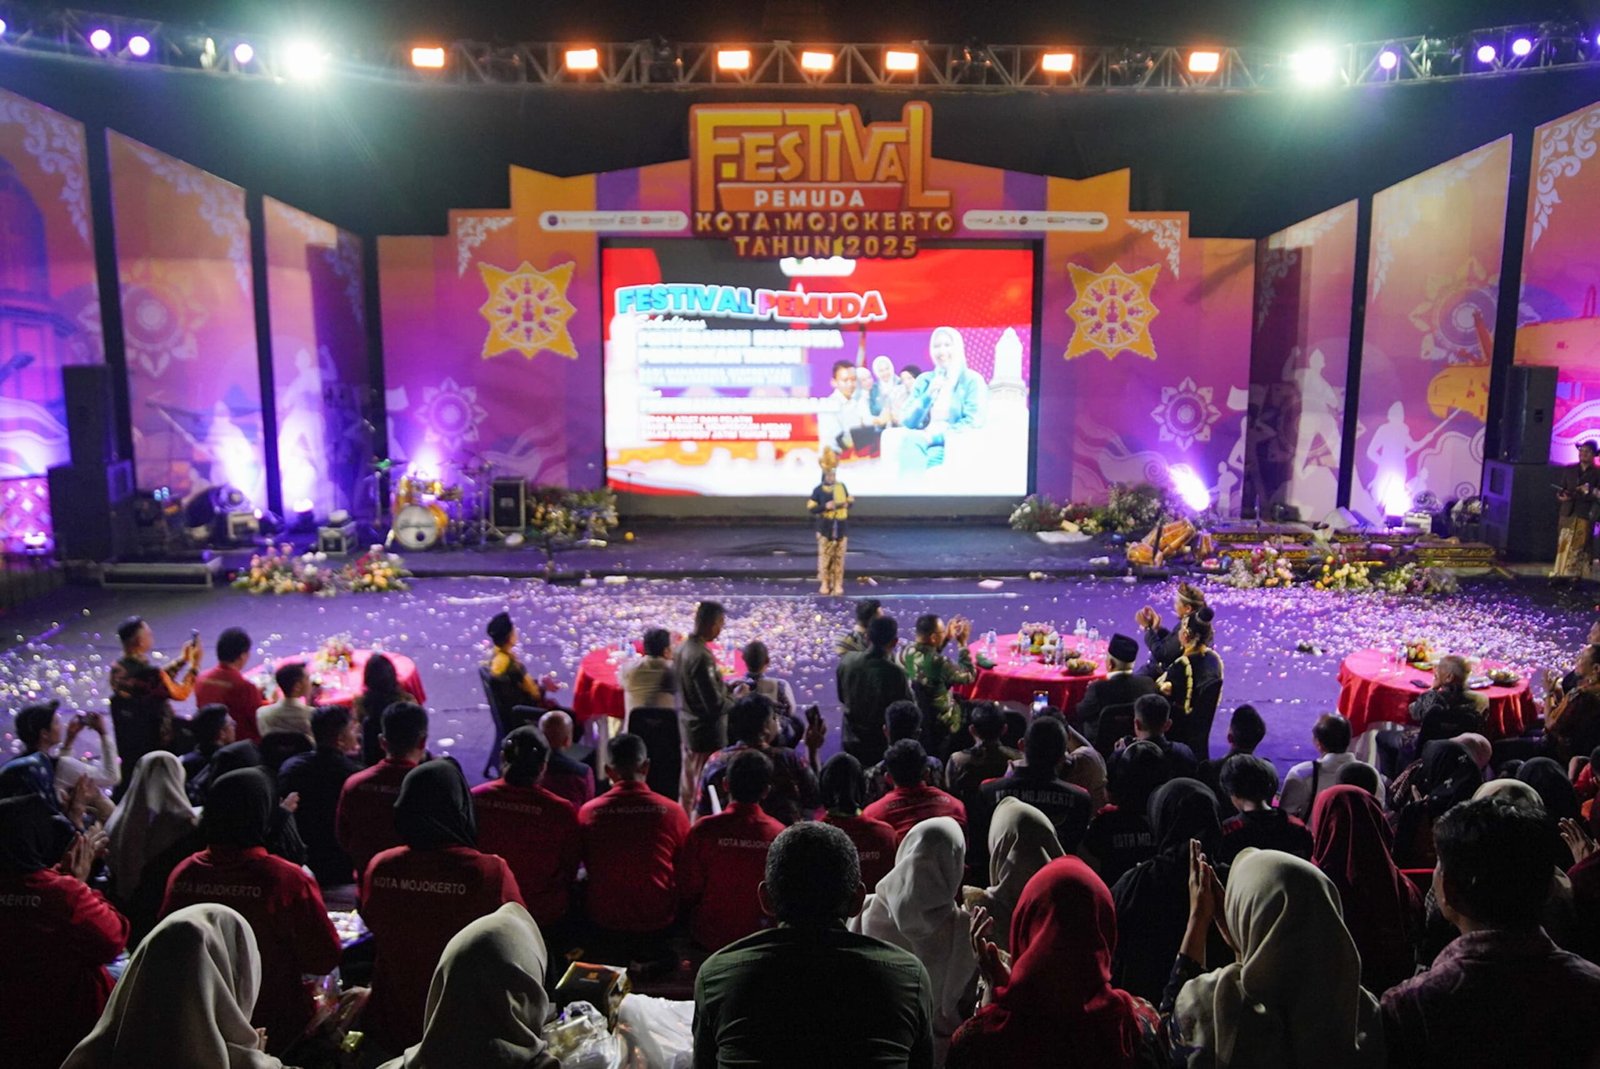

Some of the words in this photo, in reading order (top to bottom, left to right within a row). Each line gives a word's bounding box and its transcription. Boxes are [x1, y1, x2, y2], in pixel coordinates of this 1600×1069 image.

[754, 189, 865, 208] PEMUDA
[697, 212, 770, 232] KOTA
[784, 211, 953, 232] MOJOKERTO
[735, 236, 831, 257] TAHUN
[845, 236, 917, 257] 2025
[617, 285, 756, 316] FESTIVAL
[757, 290, 886, 321] PEMUDA
[717, 838, 738, 846] KOTA
[196, 883, 262, 898] MOJOKERTO
[373, 877, 398, 888] KOTA
[400, 879, 467, 895] MOJOKERTO
